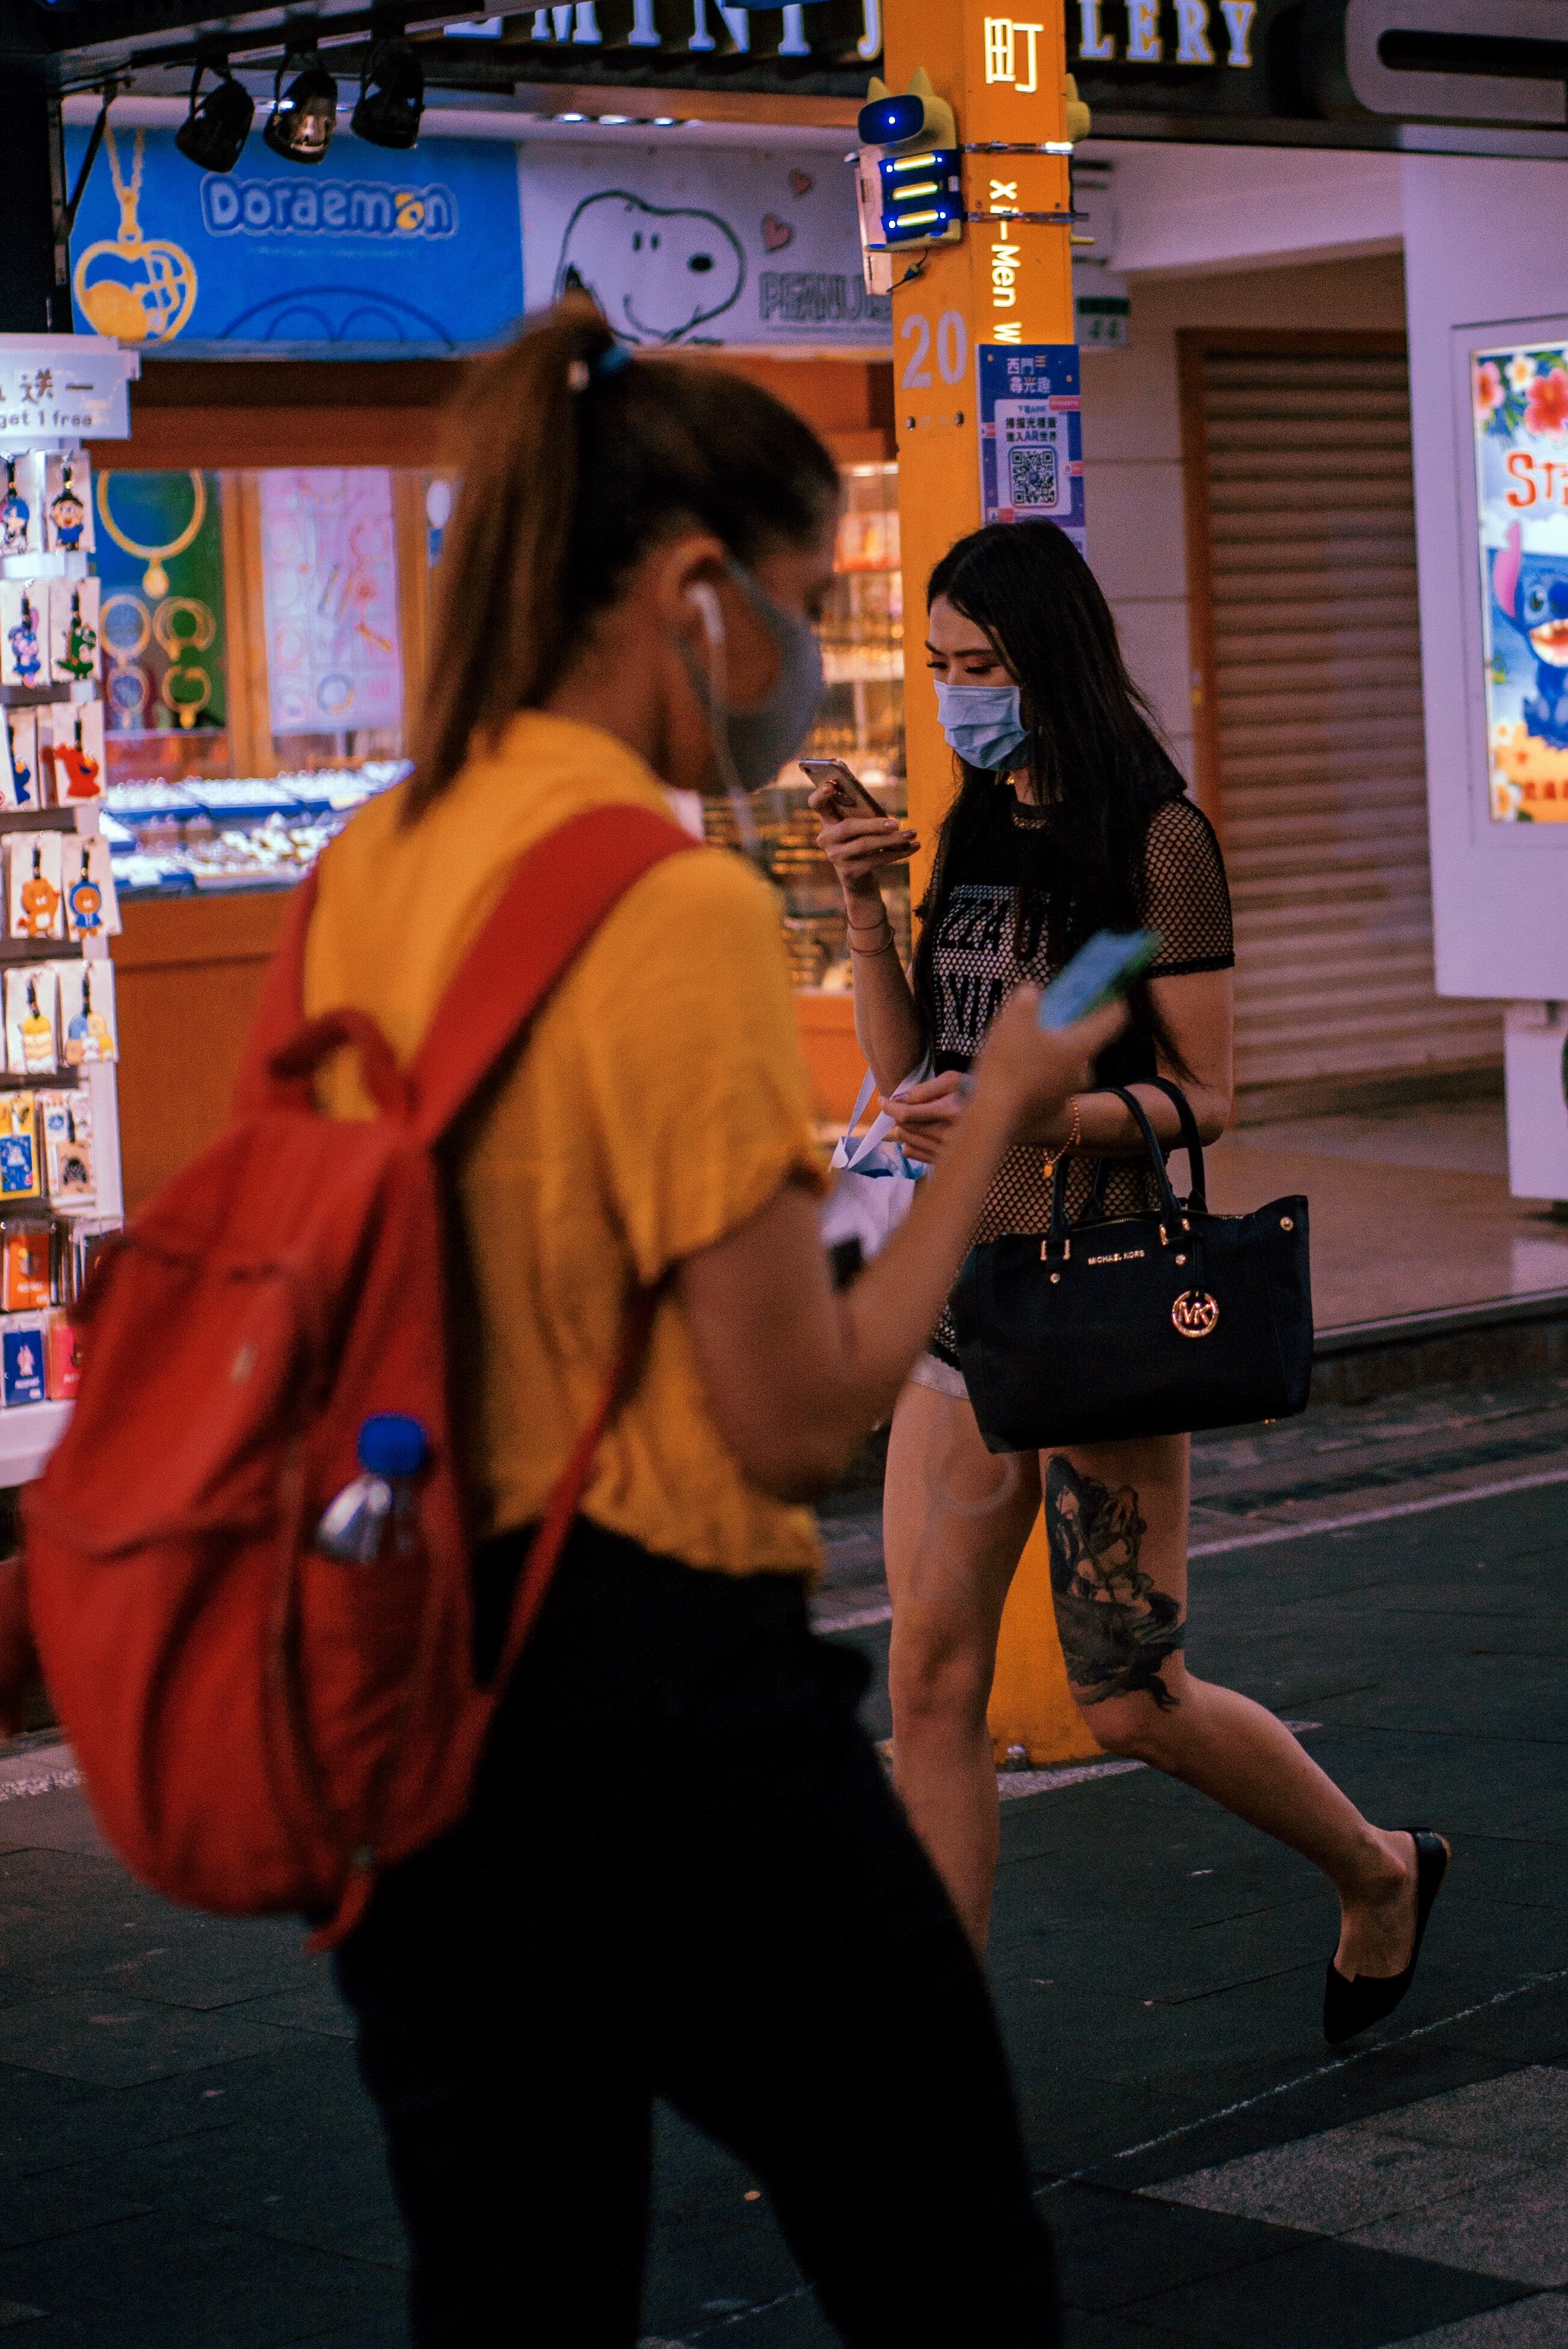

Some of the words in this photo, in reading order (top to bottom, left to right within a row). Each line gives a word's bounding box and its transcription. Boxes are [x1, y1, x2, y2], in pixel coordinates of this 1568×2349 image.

[984, 17, 1044, 93] 町
[201, 173, 458, 239] Doraemon
[900, 310, 967, 389] 20
[0, 368, 94, 405] 送一
[53, 410, 92, 428] free
